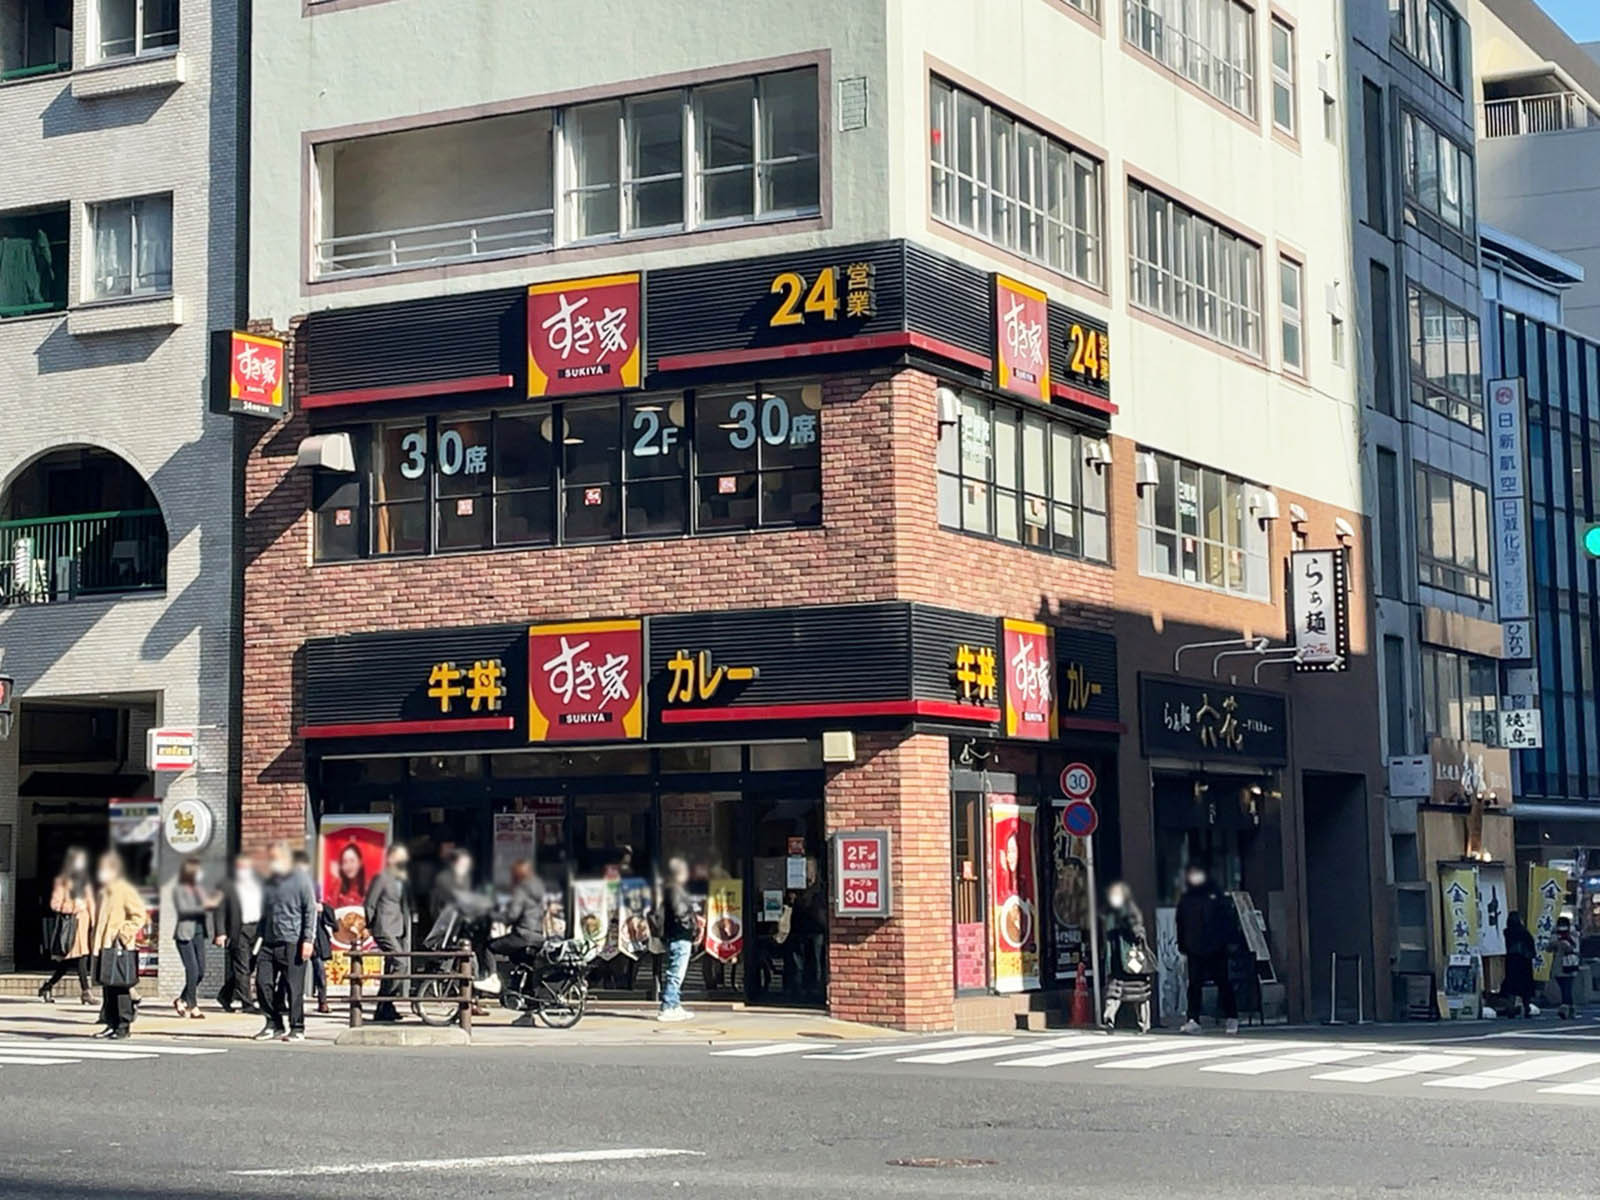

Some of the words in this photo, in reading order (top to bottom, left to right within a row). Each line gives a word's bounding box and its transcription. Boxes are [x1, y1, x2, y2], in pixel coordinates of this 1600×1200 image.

[769, 269, 839, 327] 24
[846, 263, 870, 318] 営業
[542, 293, 629, 363] すき家
[1003, 293, 1044, 368] すき家
[1070, 324, 1099, 378] 24
[236, 343, 277, 386] すき家
[564, 367, 605, 378] SUKIYA
[632, 411, 678, 457] 2F
[729, 399, 818, 450] 30席
[401, 430, 487, 479] 30席
[1304, 558, 1328, 636] らぁ麺
[429, 661, 502, 712] 牛丼
[543, 637, 629, 709] すき家
[667, 650, 756, 703] カレー
[957, 645, 996, 700] 牛丼
[1012, 633, 1051, 706] すき家
[1066, 661, 1102, 709] カレー
[566, 713, 605, 724] SUKIYA
[1068, 773, 1088, 789] 30
[847, 845, 868, 860] 2F
